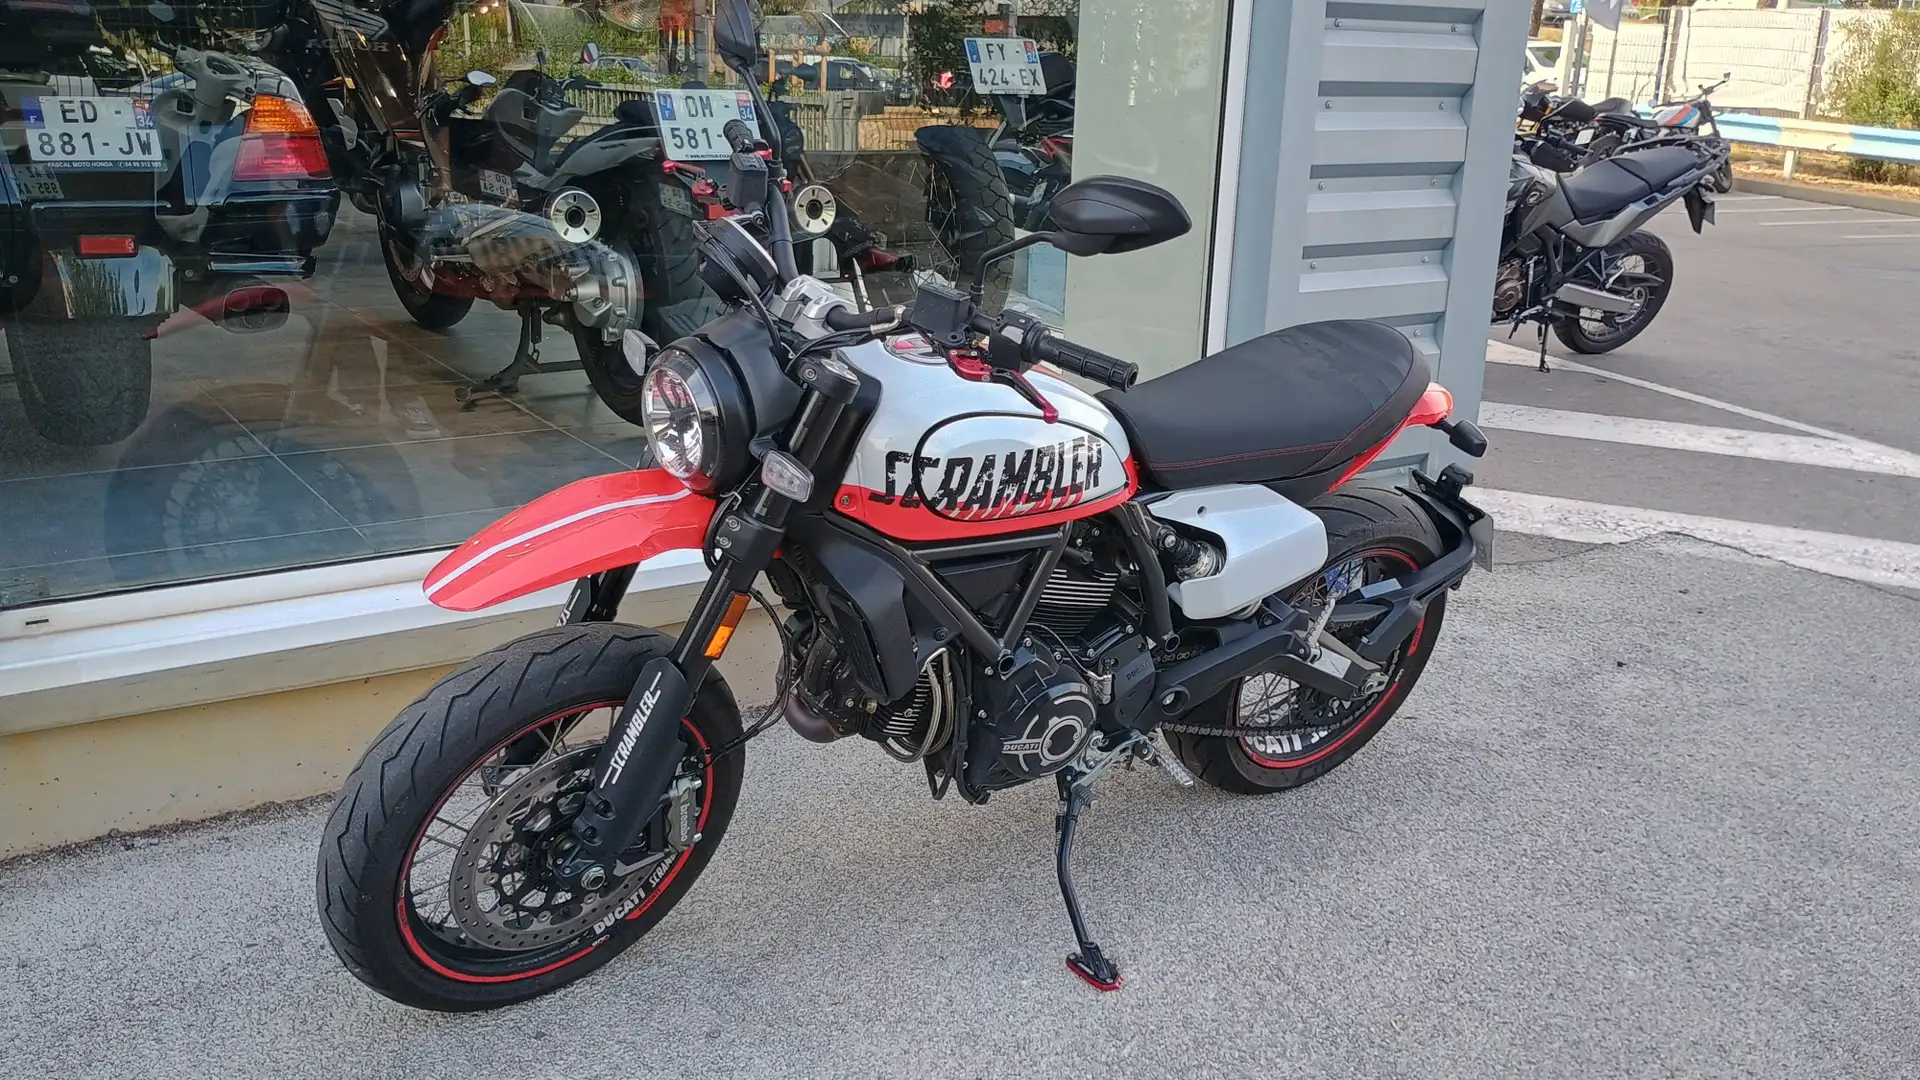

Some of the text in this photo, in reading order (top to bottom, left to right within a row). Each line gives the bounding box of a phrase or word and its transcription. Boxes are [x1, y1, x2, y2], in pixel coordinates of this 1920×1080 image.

[985, 43, 1005, 60] FY
[1027, 51, 1037, 63] 34
[979, 68, 1040, 86] 424-EX
[59, 100, 98, 123] ED
[684, 95, 714, 118] DM
[740, 107, 753, 120] 34
[29, 115, 37, 124] F
[136, 115, 154, 128] 34
[37, 132, 153, 156] 881-JW
[868, 435, 1103, 509] SCRAMBLER
[607, 686, 660, 781] SCRAMBLER
[1003, 742, 1039, 751] DUCATI
[680, 803, 691, 842] brembo
[593, 887, 646, 935] DUCATI
